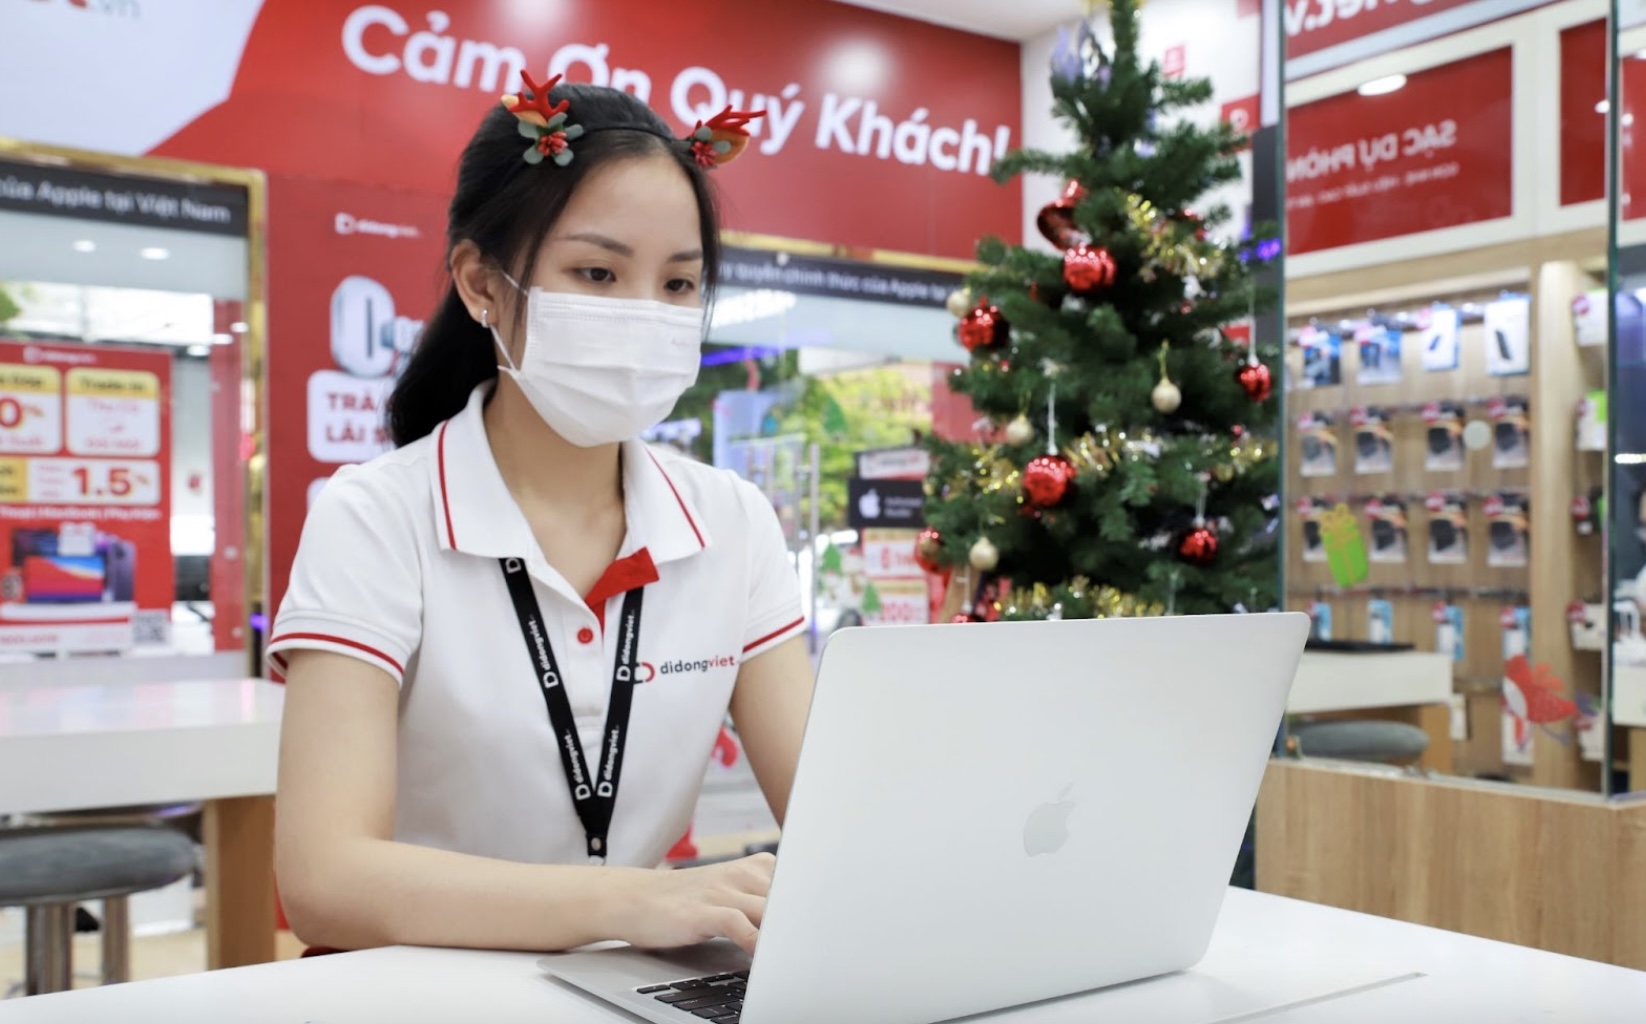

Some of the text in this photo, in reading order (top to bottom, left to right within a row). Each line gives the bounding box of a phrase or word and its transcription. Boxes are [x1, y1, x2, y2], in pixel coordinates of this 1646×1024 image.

[342, 5, 526, 97] Cảm
[670, 66, 804, 154] Quý
[815, 93, 1011, 176] Khách!
[36, 180, 102, 208] Apple
[180, 198, 231, 223] Nam
[660, 655, 735, 675] didongviet
